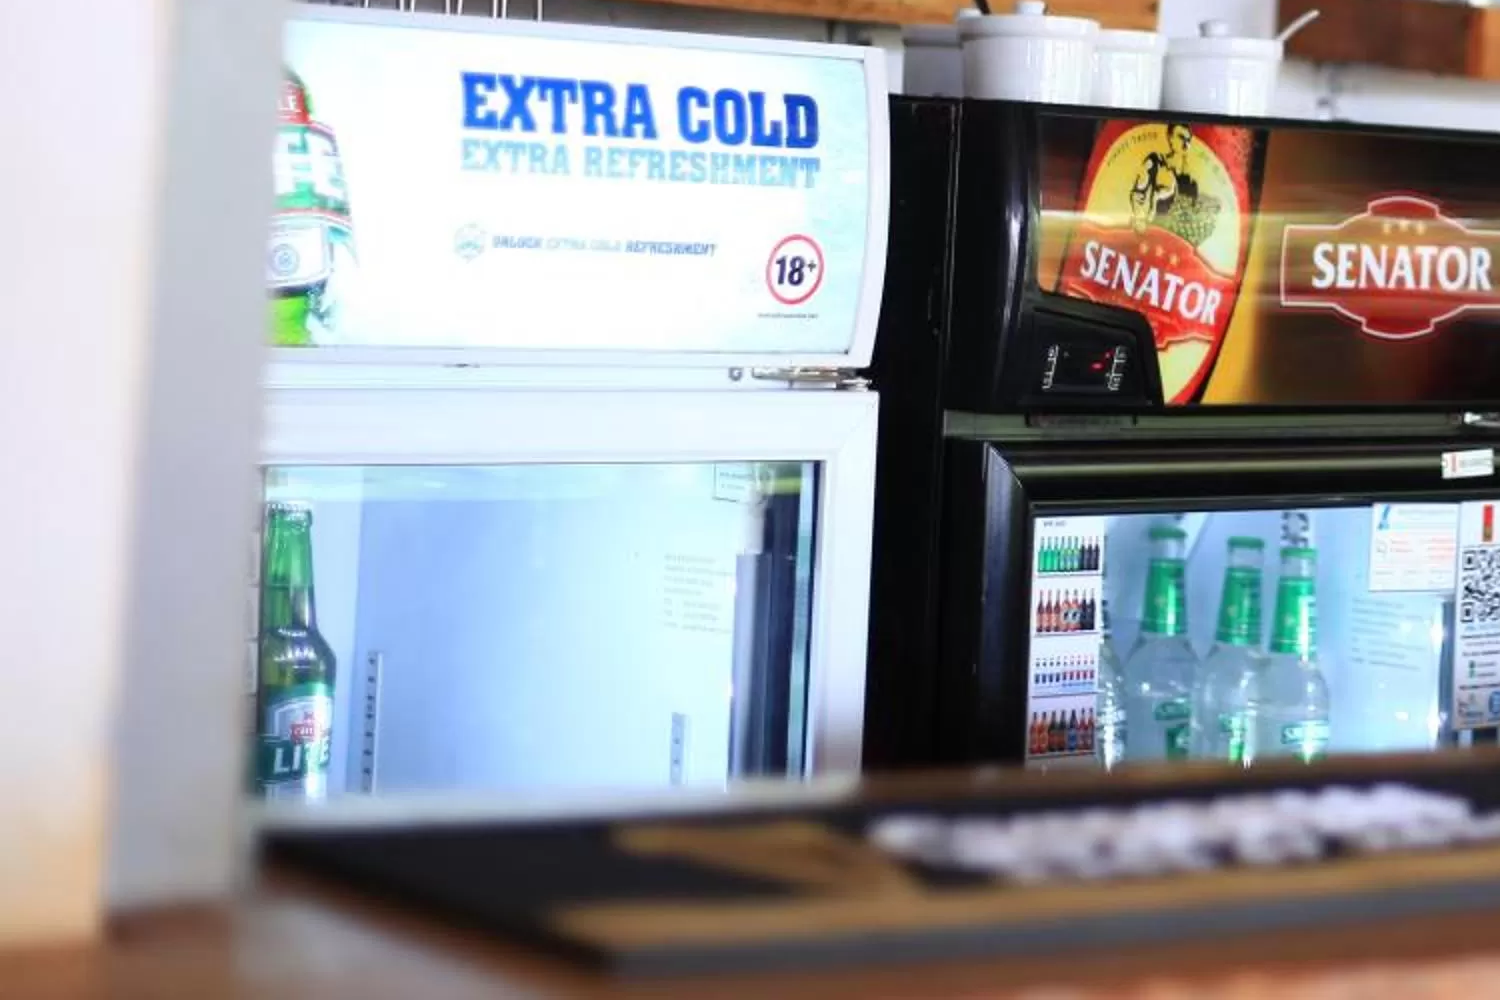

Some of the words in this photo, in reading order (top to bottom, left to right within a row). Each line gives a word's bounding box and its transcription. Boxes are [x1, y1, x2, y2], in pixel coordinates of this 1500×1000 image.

[460, 71, 658, 139] EXTRA
[676, 86, 820, 149] COLD
[460, 138, 570, 176] EXTRA
[584, 145, 821, 188] REFRESHMENT
[775, 255, 817, 287] 18+
[1080, 239, 1222, 326] SENATOR
[1312, 242, 1493, 292] SENATOR
